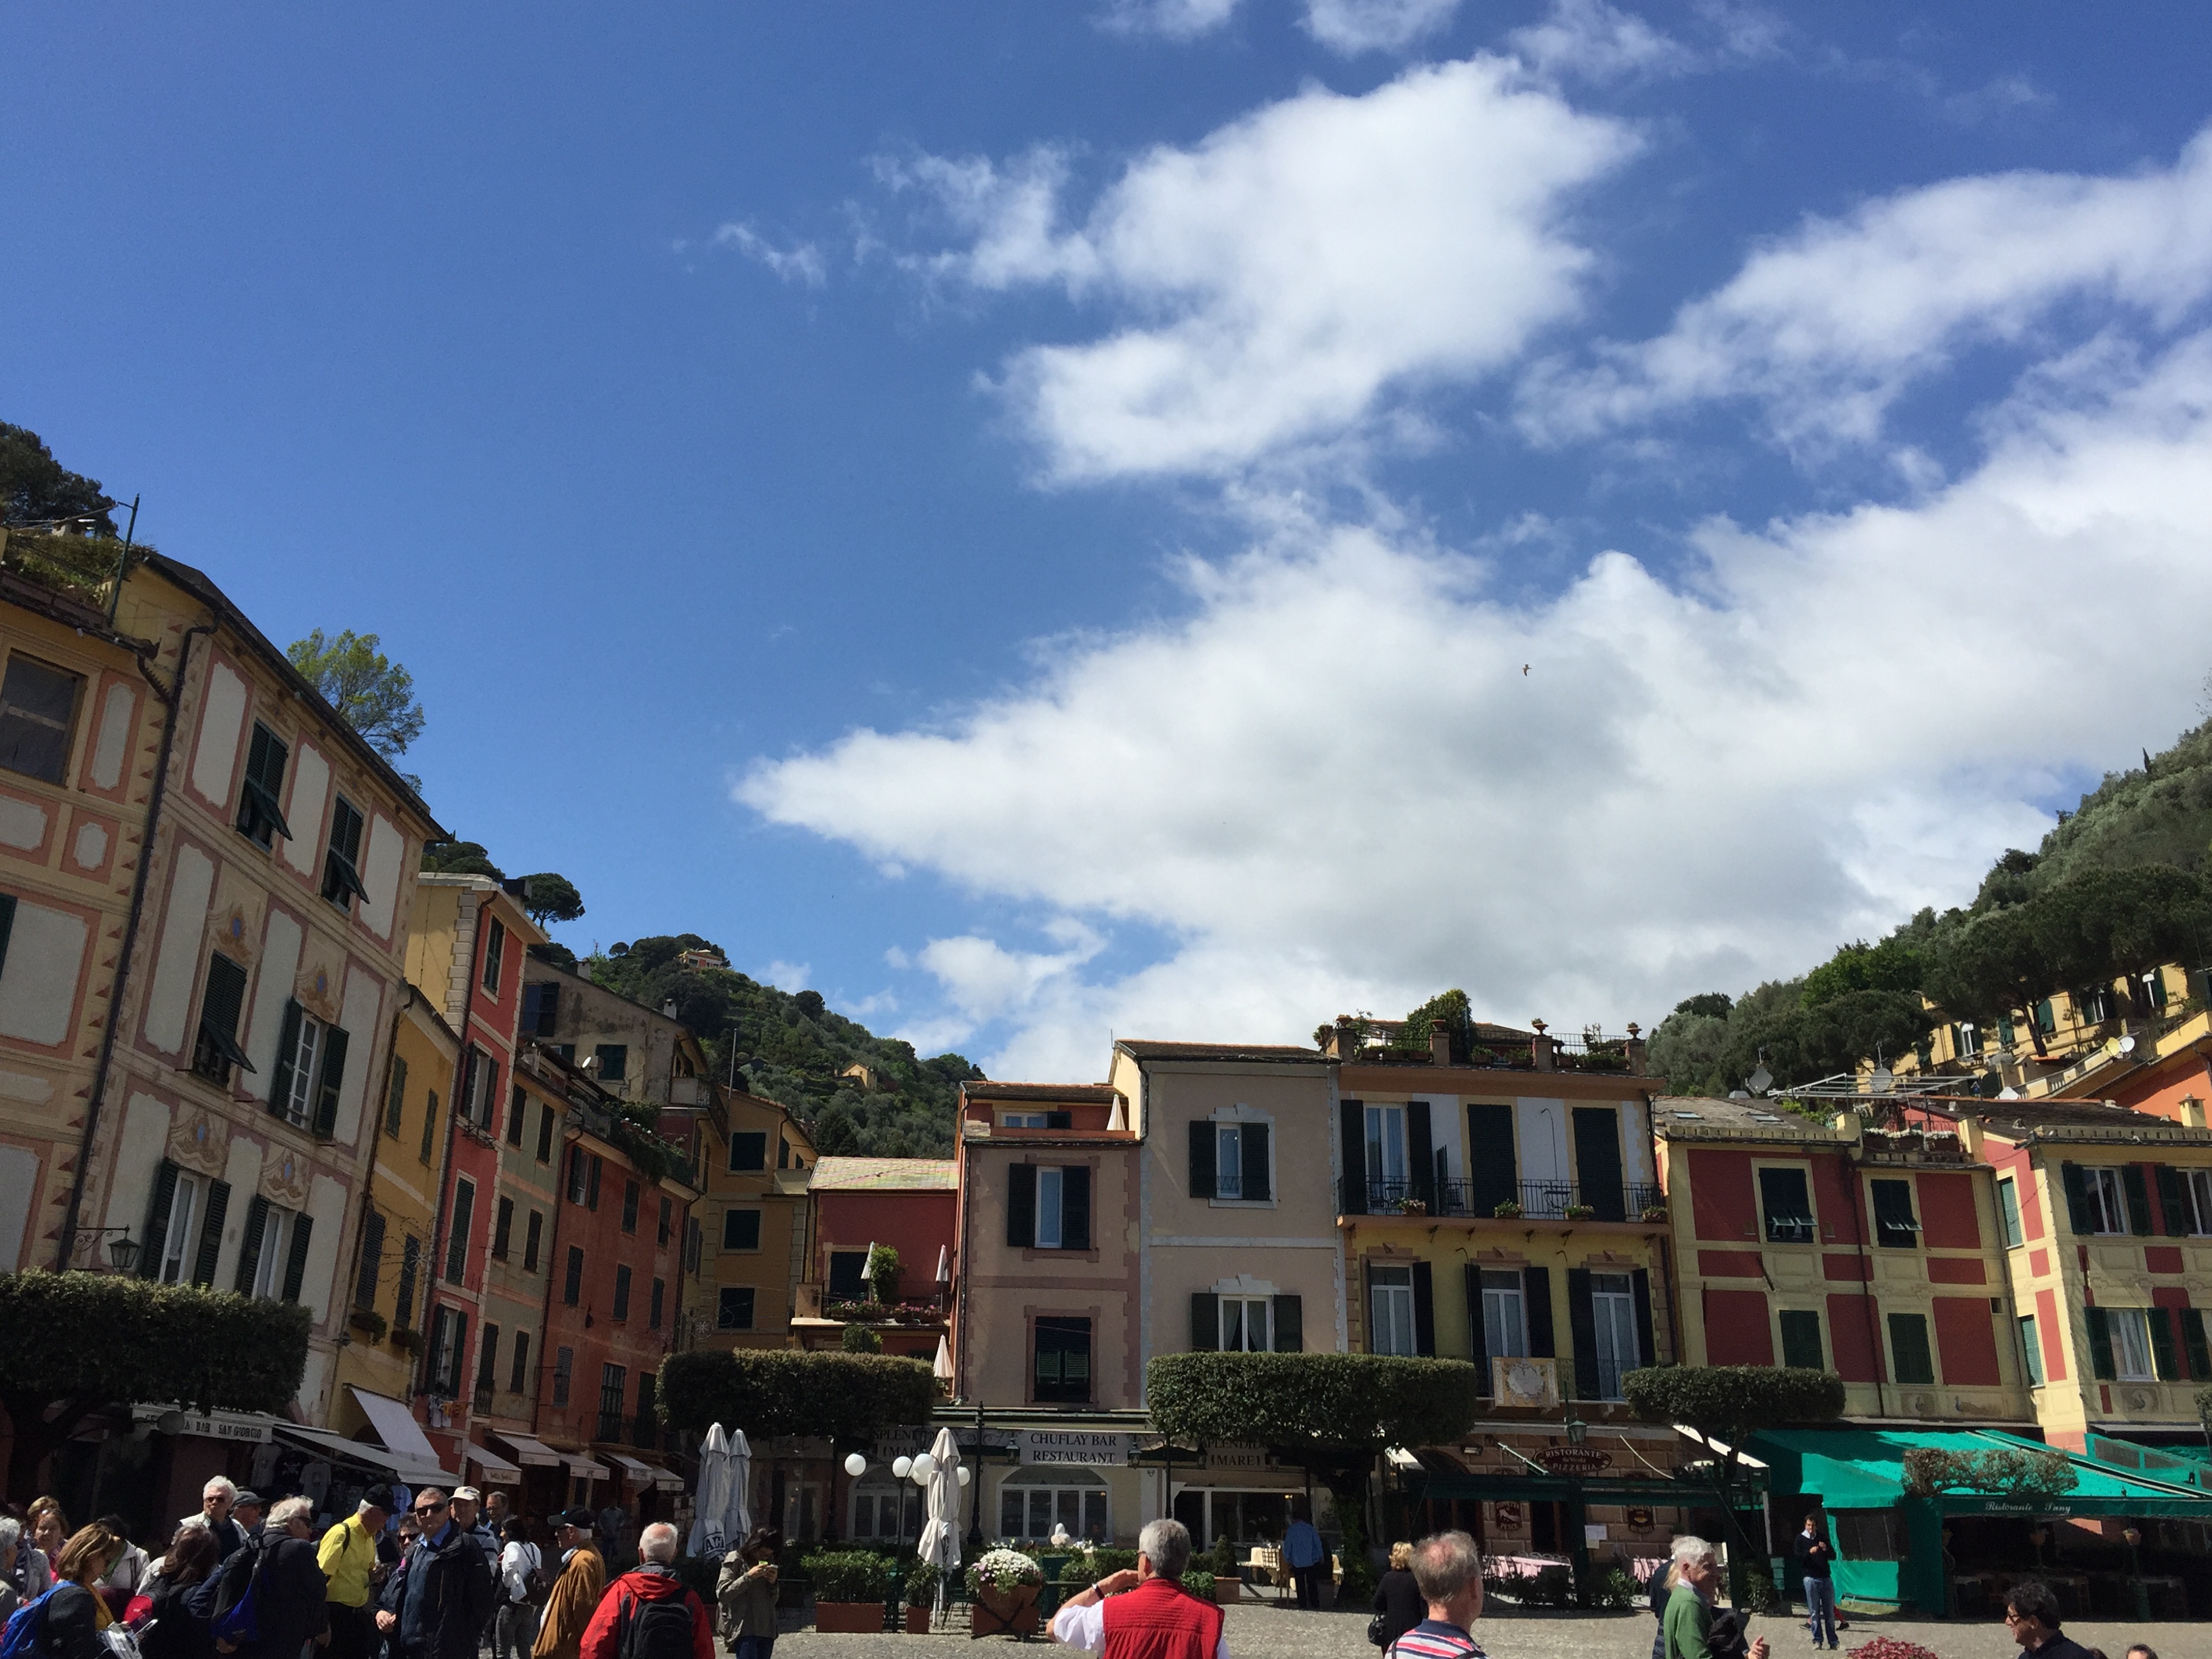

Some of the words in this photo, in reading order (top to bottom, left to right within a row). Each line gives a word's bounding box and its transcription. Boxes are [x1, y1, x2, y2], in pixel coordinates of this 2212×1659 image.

[196, 1421, 210, 1433] BAR
[218, 1424, 232, 1435] SAN
[233, 1426, 262, 1438] GIORGIO
[1031, 1433, 1089, 1445] CHUFLAY
[1092, 1435, 1117, 1446] BAR
[1033, 1450, 1116, 1462] RESTAURANT
[1545, 1449, 1602, 1459] RISTORANTE
[1553, 1463, 1598, 1472] PIZZERIA
[1985, 1501, 2033, 1511] Ristorante
